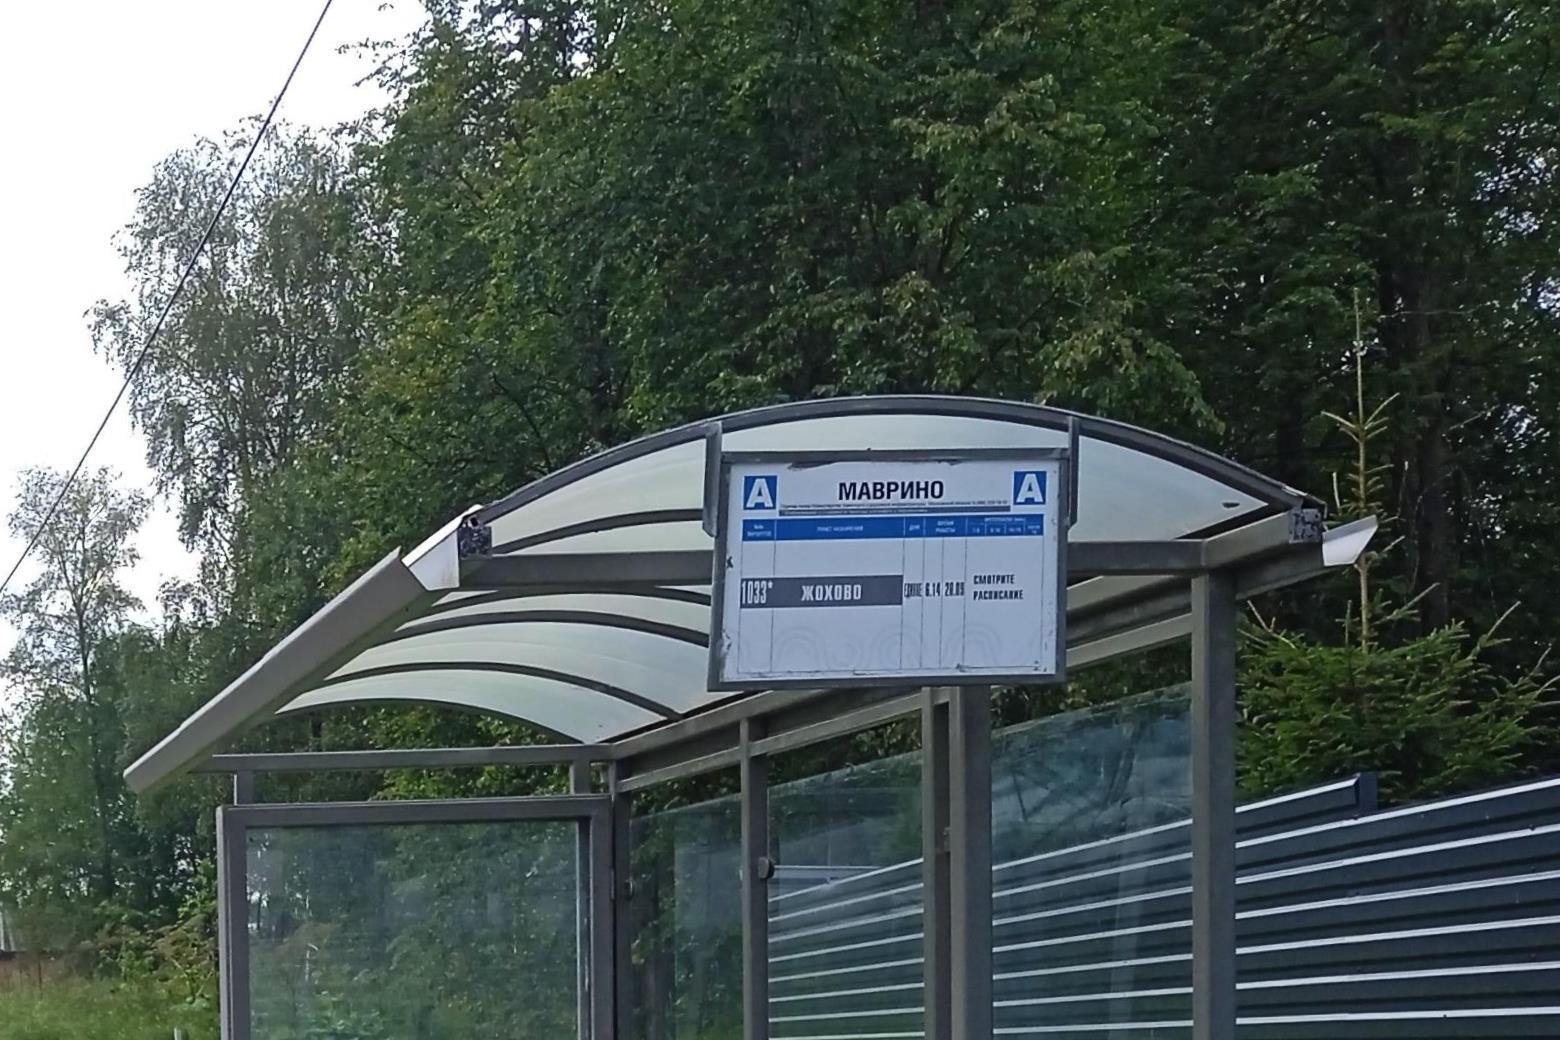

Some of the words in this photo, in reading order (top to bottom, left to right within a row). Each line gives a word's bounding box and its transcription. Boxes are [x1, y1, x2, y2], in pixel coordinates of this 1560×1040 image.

[745, 477, 774, 508] А
[838, 480, 944, 501] МАВРИНО
[1015, 473, 1044, 503] А
[973, 574, 1015, 585] СМОТРИТЕ
[801, 584, 862, 601] ЖОХОВО
[973, 589, 1024, 601] РАСПИСАНИЕ
